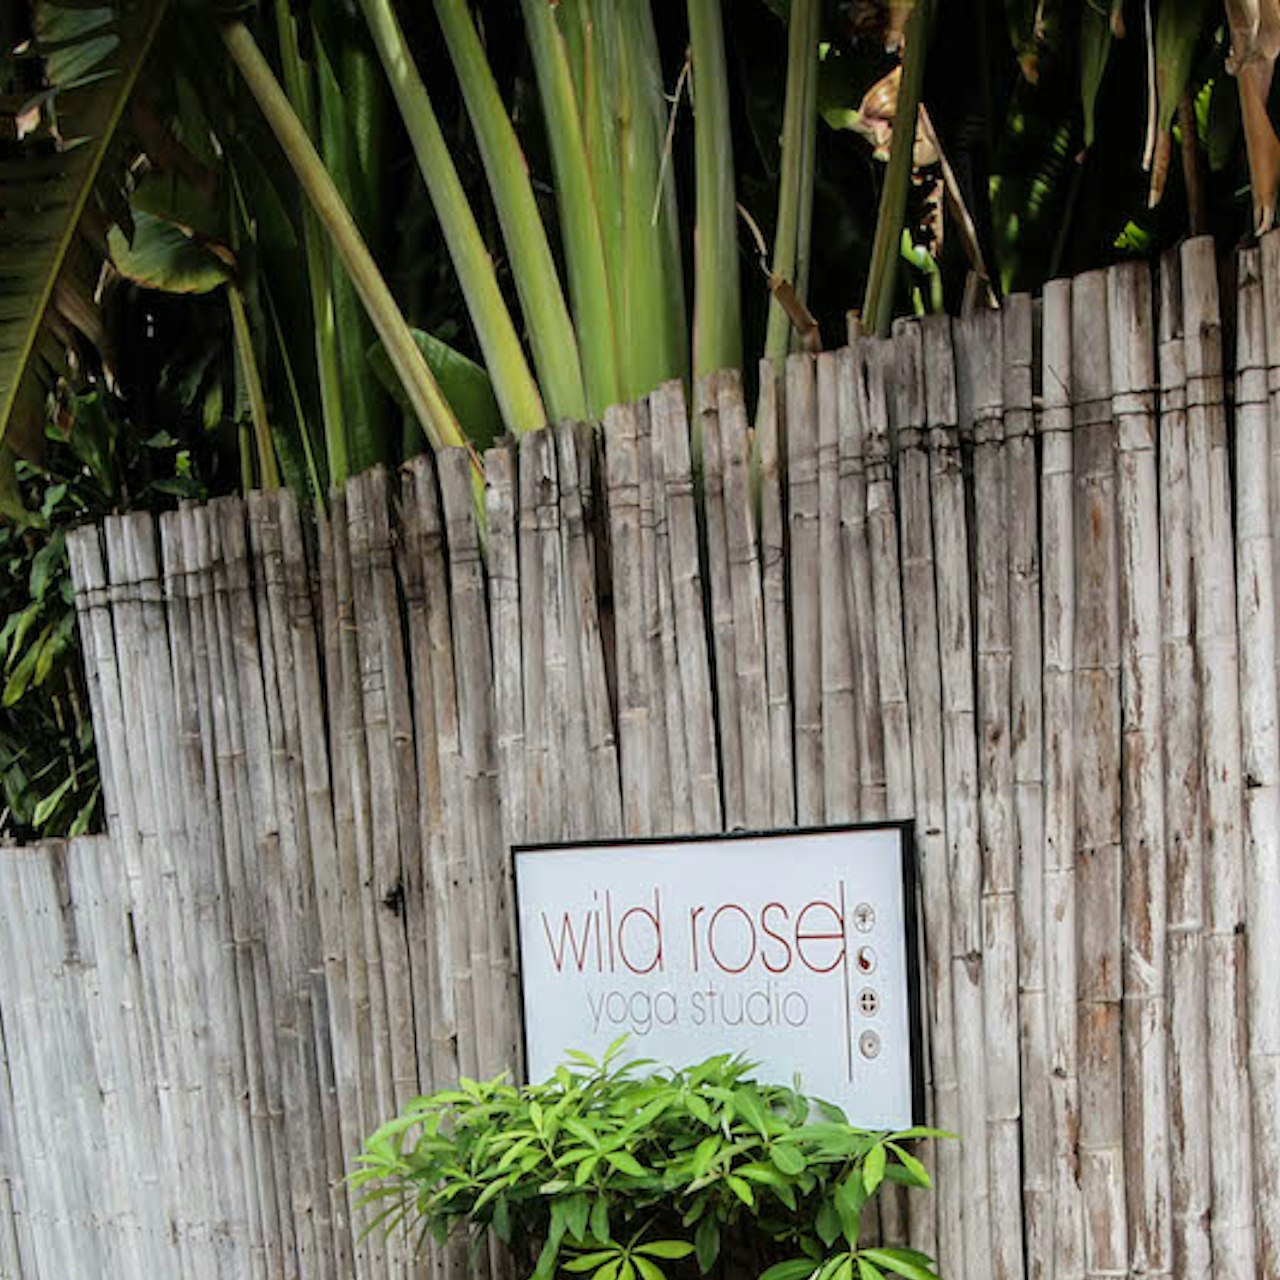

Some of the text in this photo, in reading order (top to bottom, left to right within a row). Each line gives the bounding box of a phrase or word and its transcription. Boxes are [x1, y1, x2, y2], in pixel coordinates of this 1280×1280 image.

[541, 886, 847, 974] wild rose
[587, 981, 810, 1036] yoga studio
